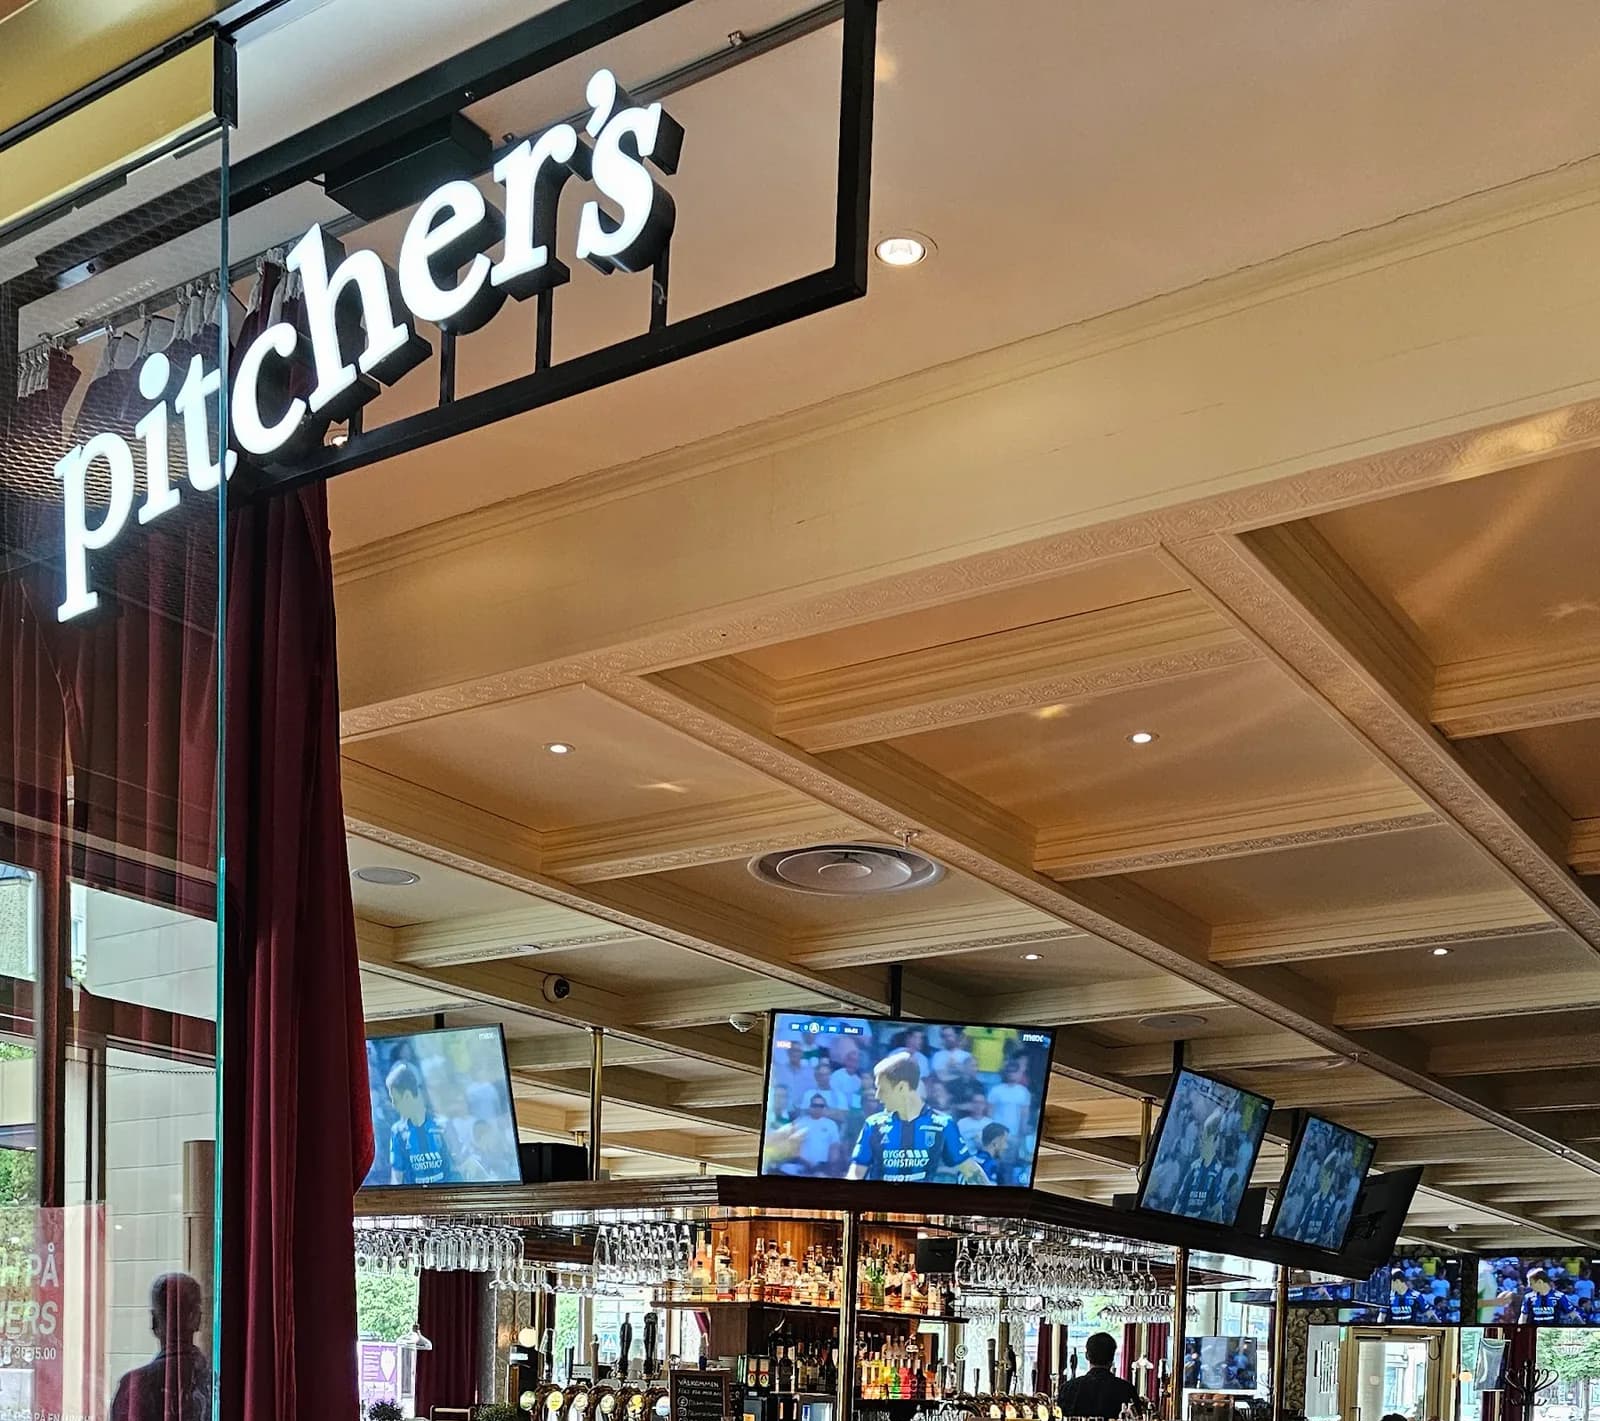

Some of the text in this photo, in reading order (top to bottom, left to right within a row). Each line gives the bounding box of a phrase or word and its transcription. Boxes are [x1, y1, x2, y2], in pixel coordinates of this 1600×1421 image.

[54, 68, 663, 624] pitcher's
[882, 1149, 906, 1159] BYGG
[25, 1242, 59, 1288] PÅ
